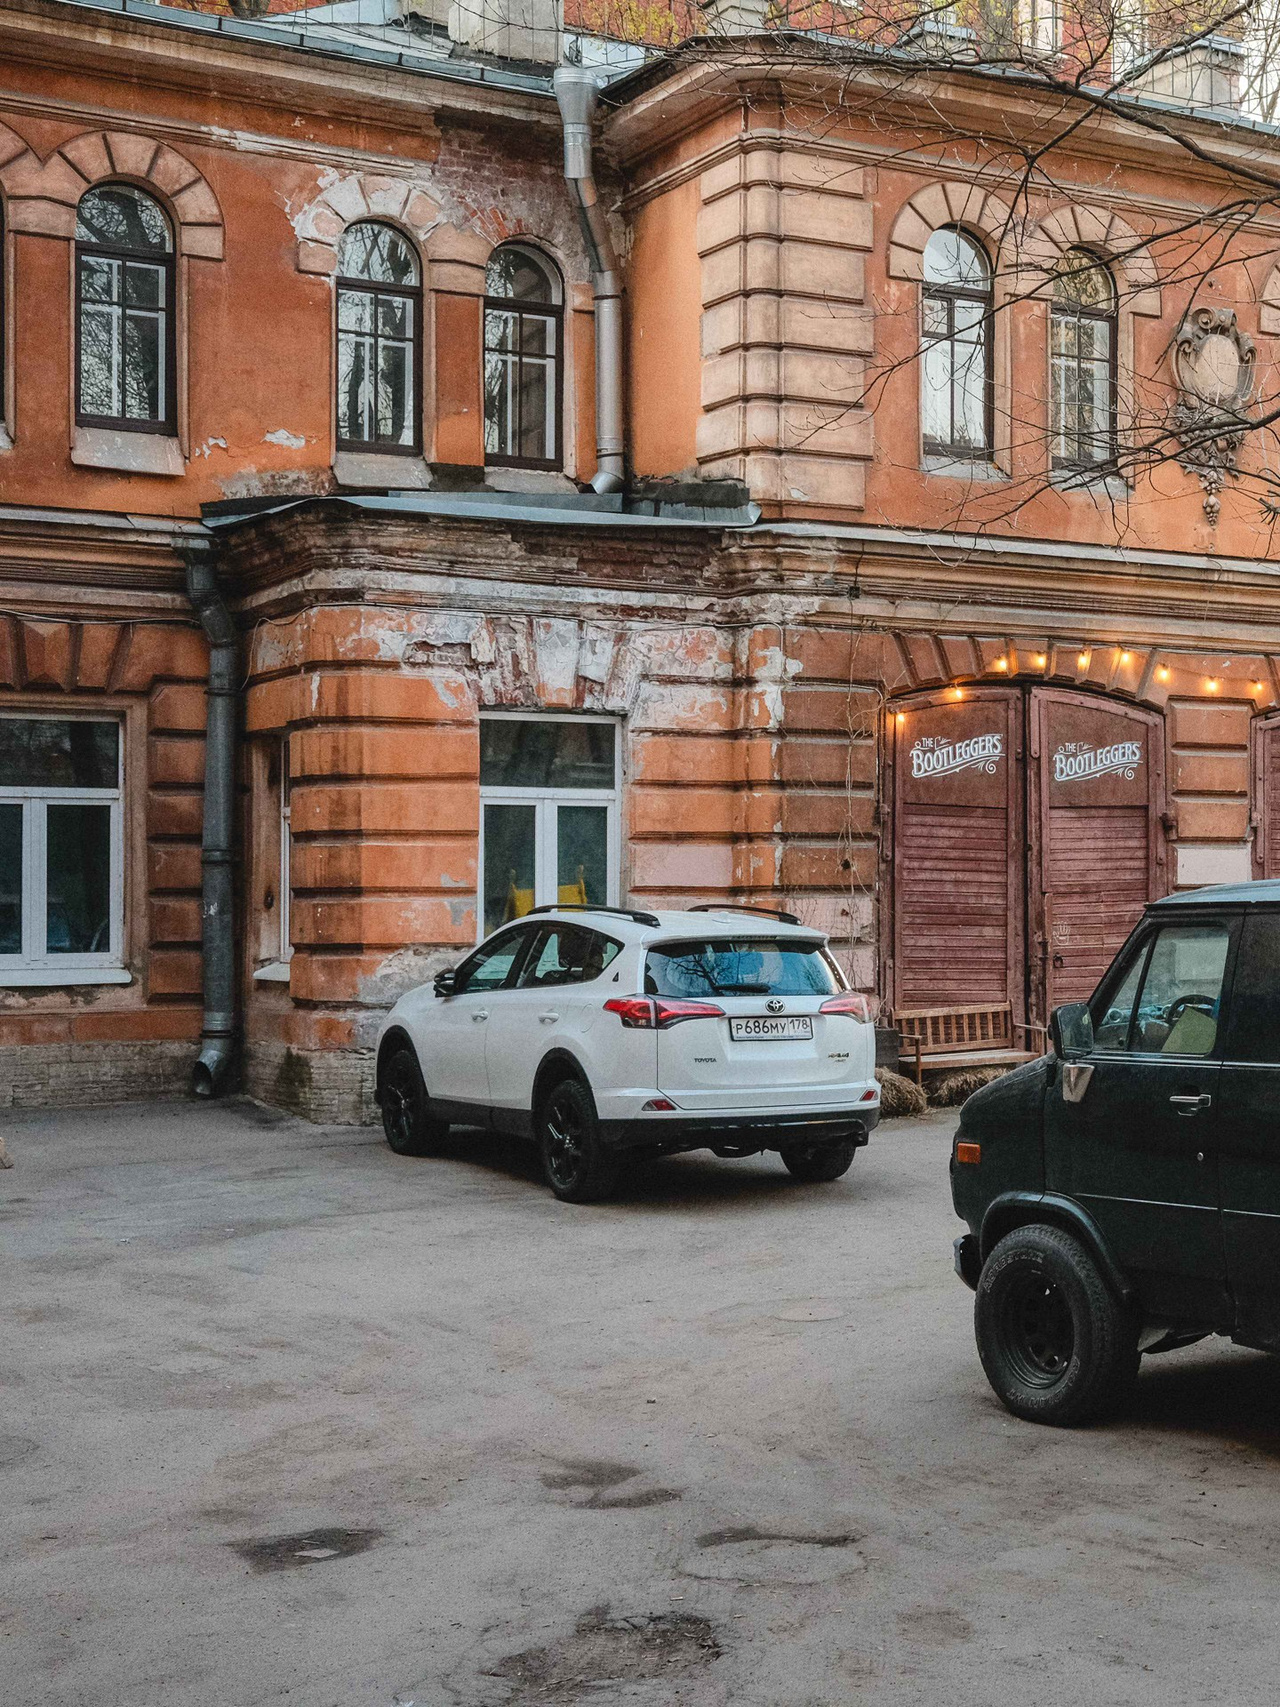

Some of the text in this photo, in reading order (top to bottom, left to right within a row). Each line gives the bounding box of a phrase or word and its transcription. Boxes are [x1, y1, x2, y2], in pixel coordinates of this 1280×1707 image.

[921, 737, 934, 748] THE
[1065, 742, 1077, 753] THE
[909, 734, 1004, 777] BOOTLEGGERS
[1053, 742, 1142, 781] BOOTLEGGERS
[789, 1018, 808, 1030] 178
